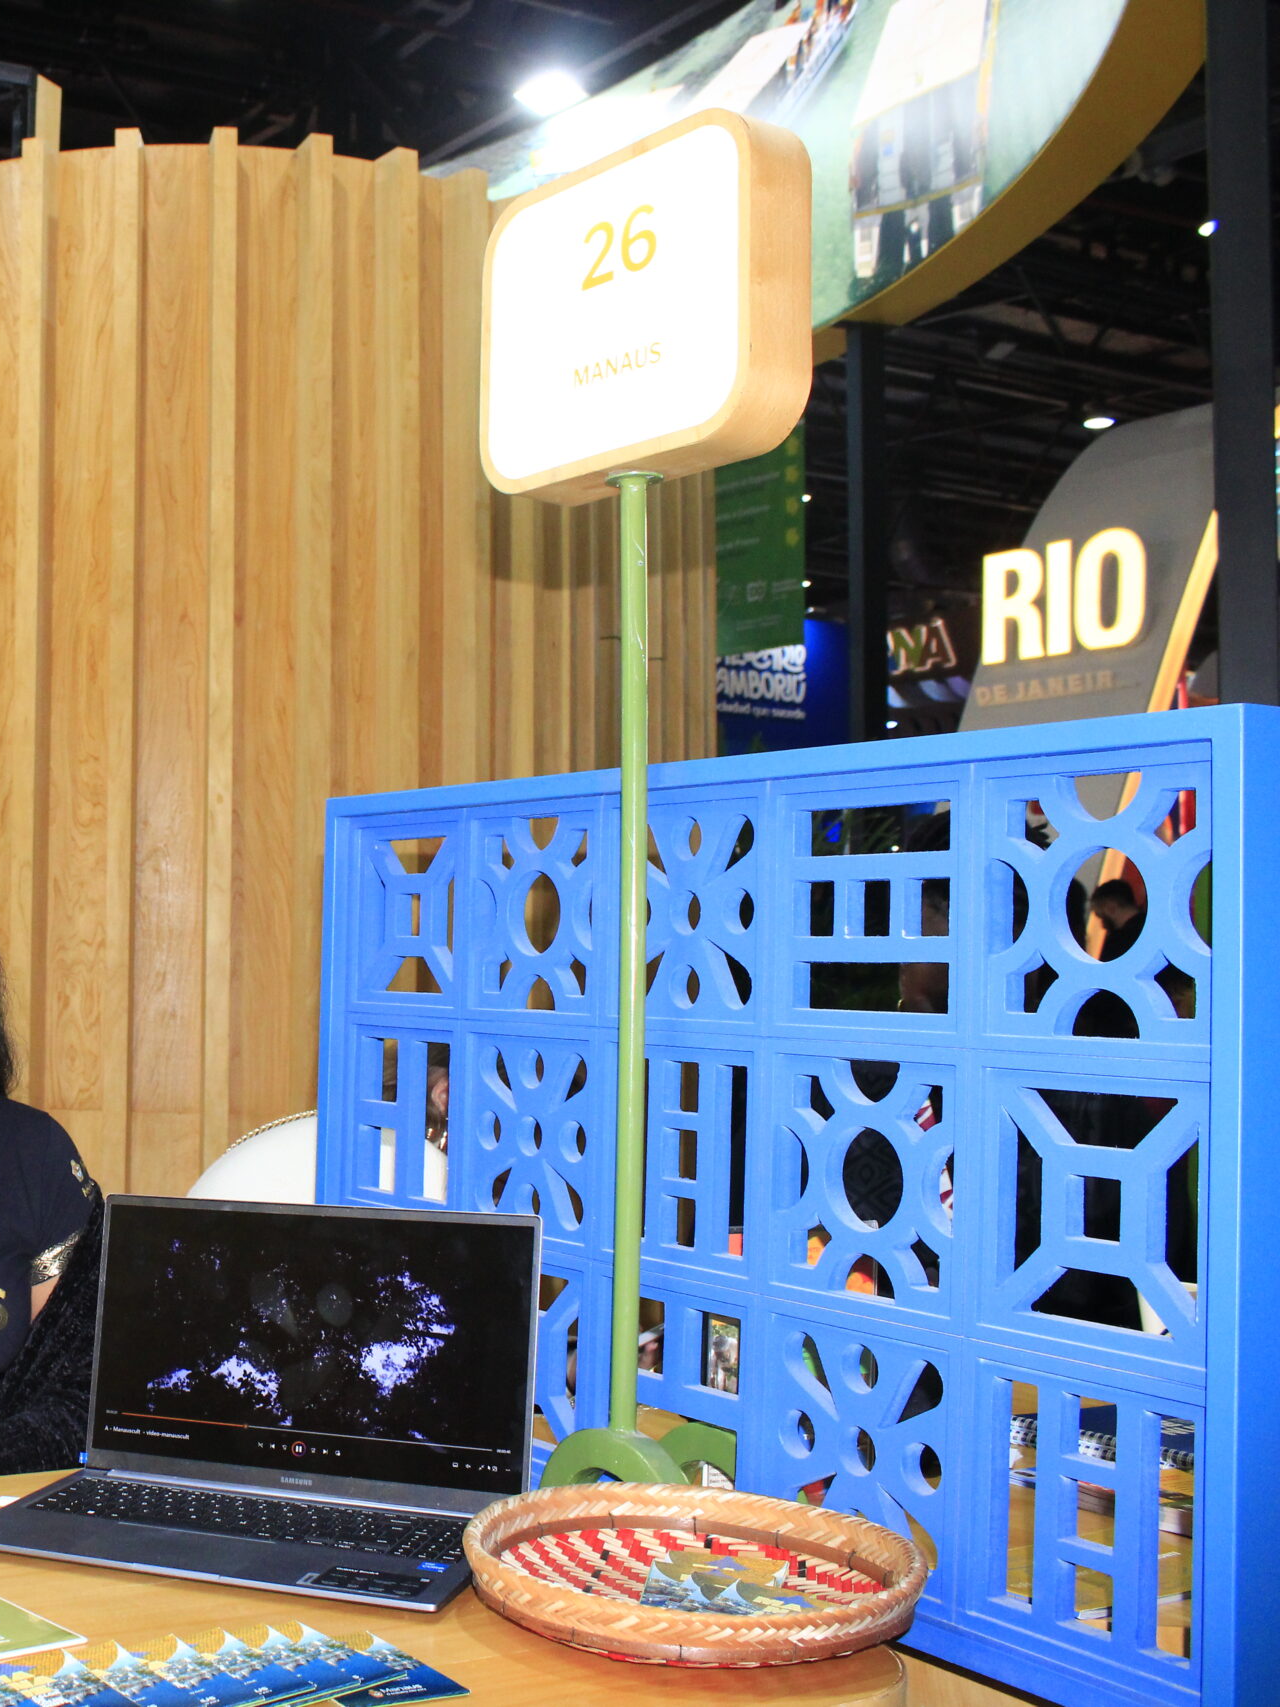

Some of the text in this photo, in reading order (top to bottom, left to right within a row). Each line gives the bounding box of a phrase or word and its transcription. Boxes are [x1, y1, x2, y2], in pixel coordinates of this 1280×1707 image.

[581, 203, 658, 291] 26
[573, 341, 663, 388] MANAUS
[981, 526, 1147, 666] RIO
[716, 667, 807, 704] AMBORIÚ
[975, 670, 1115, 707] DE JANEIR
[280, 1476, 313, 1486] SAMSUNG
